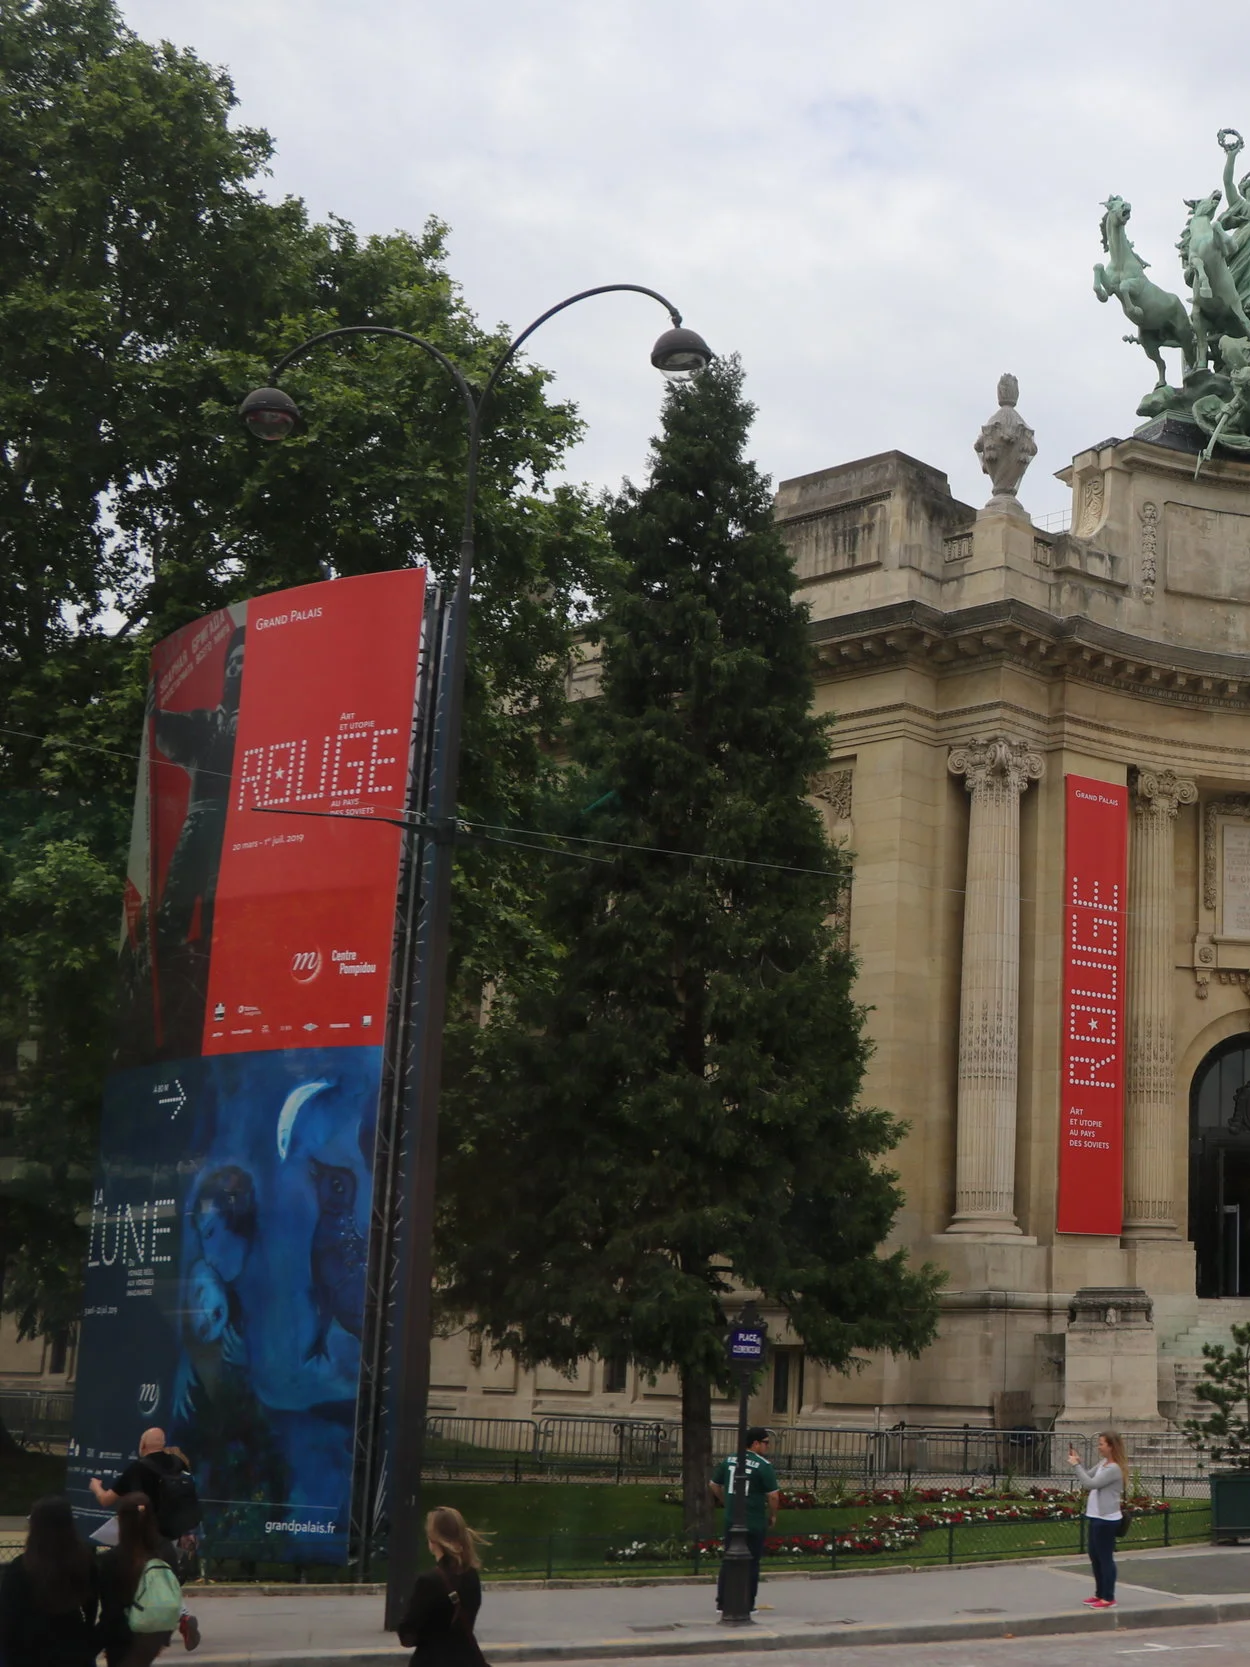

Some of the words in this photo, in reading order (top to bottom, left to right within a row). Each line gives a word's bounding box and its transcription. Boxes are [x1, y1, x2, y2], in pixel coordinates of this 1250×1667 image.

[256, 617, 288, 631] GRAND
[290, 607, 323, 622] PALAIS
[340, 712, 356, 720] ART
[350, 720, 375, 729] UTOPIE
[237, 728, 398, 811] ROUGE
[1075, 789, 1098, 801] GRAND
[1098, 795, 1119, 806] PALAIS
[331, 949, 357, 961] Centre
[339, 962, 376, 976] Pompidou
[1069, 876, 1119, 1088] ROUGE
[1070, 1106, 1083, 1115] ART
[1079, 1119, 1103, 1128] UTOPIE
[1080, 1130, 1096, 1138] PAYS
[1069, 1139, 1082, 1147] DES
[1083, 1140, 1110, 1149] SOVIETS
[93, 1188, 103, 1206] LA
[87, 1199, 175, 1267] LUNE
[738, 1333, 757, 1341] PLACE
[265, 1519, 336, 1535] grandpalais.fr
